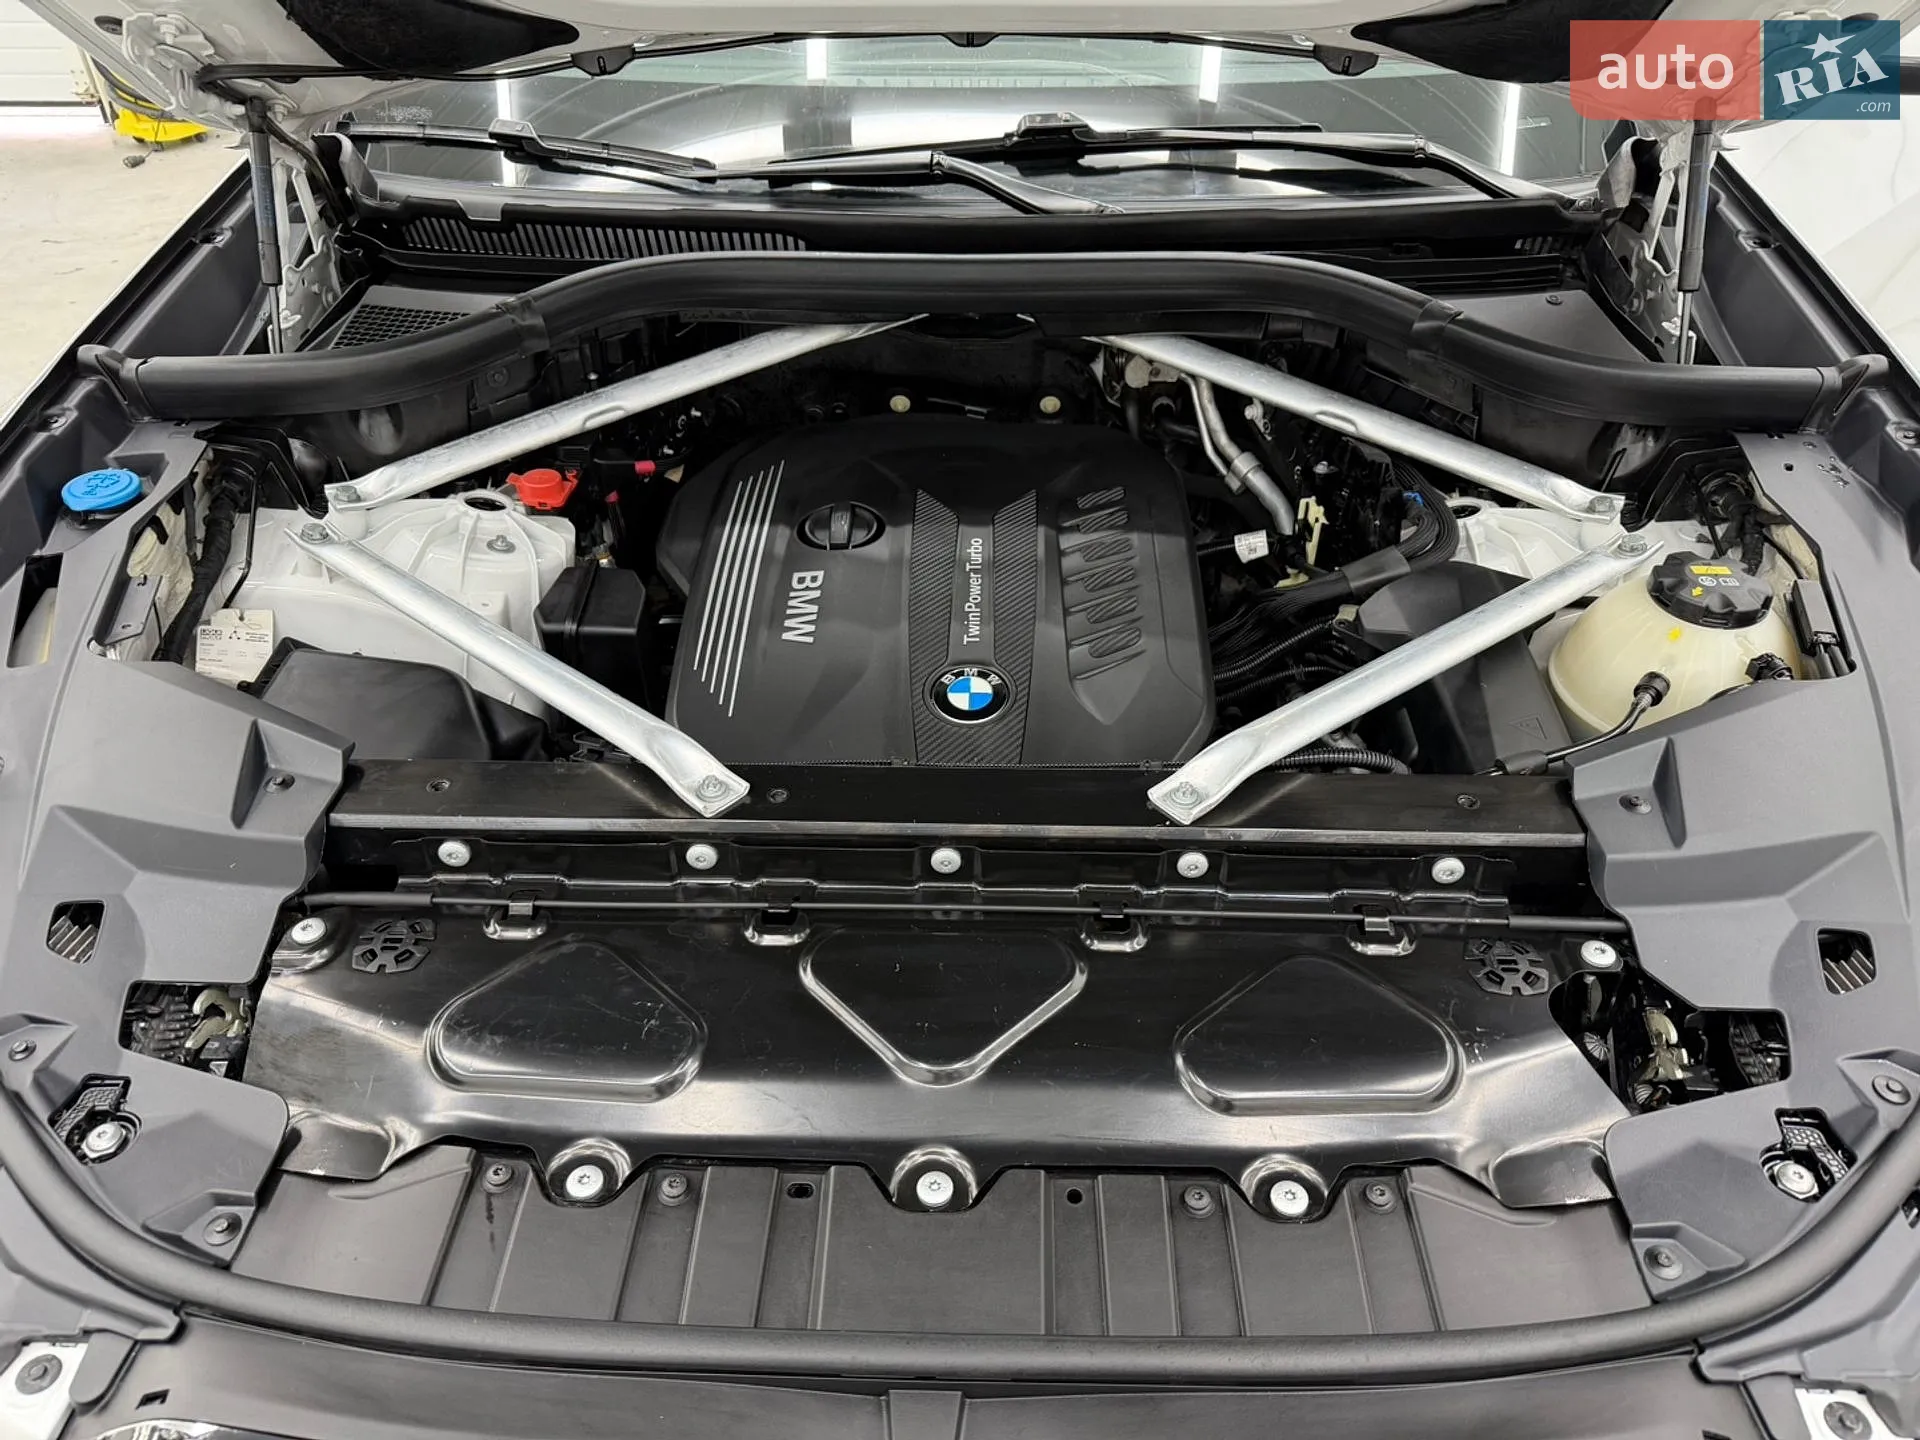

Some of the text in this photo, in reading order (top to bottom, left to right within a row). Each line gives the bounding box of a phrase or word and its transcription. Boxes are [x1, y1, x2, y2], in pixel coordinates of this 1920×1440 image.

[781, 570, 825, 644] BMW
[962, 537, 984, 646] TwinPower Turbo
[940, 667, 1002, 686] BMW
